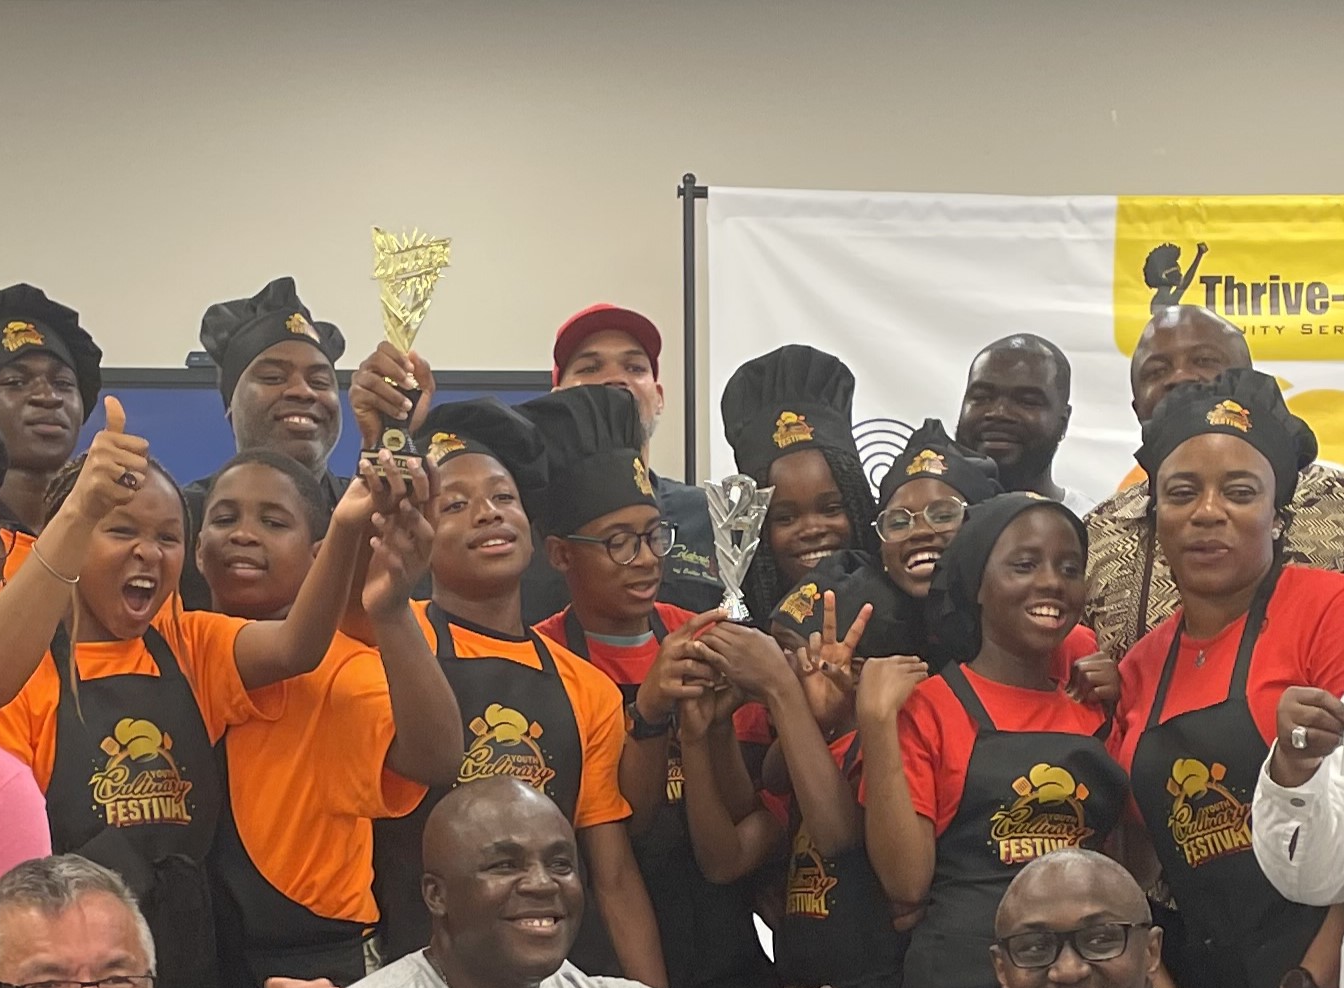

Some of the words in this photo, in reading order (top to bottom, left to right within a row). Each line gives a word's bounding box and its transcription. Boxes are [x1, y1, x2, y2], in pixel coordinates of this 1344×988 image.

[88, 765, 193, 804] Culinary
[457, 744, 556, 788] Culinary
[106, 797, 192, 826] FESTIVAL
[990, 805, 1095, 846] Culinary
[1183, 824, 1253, 865] FESTIVAL
